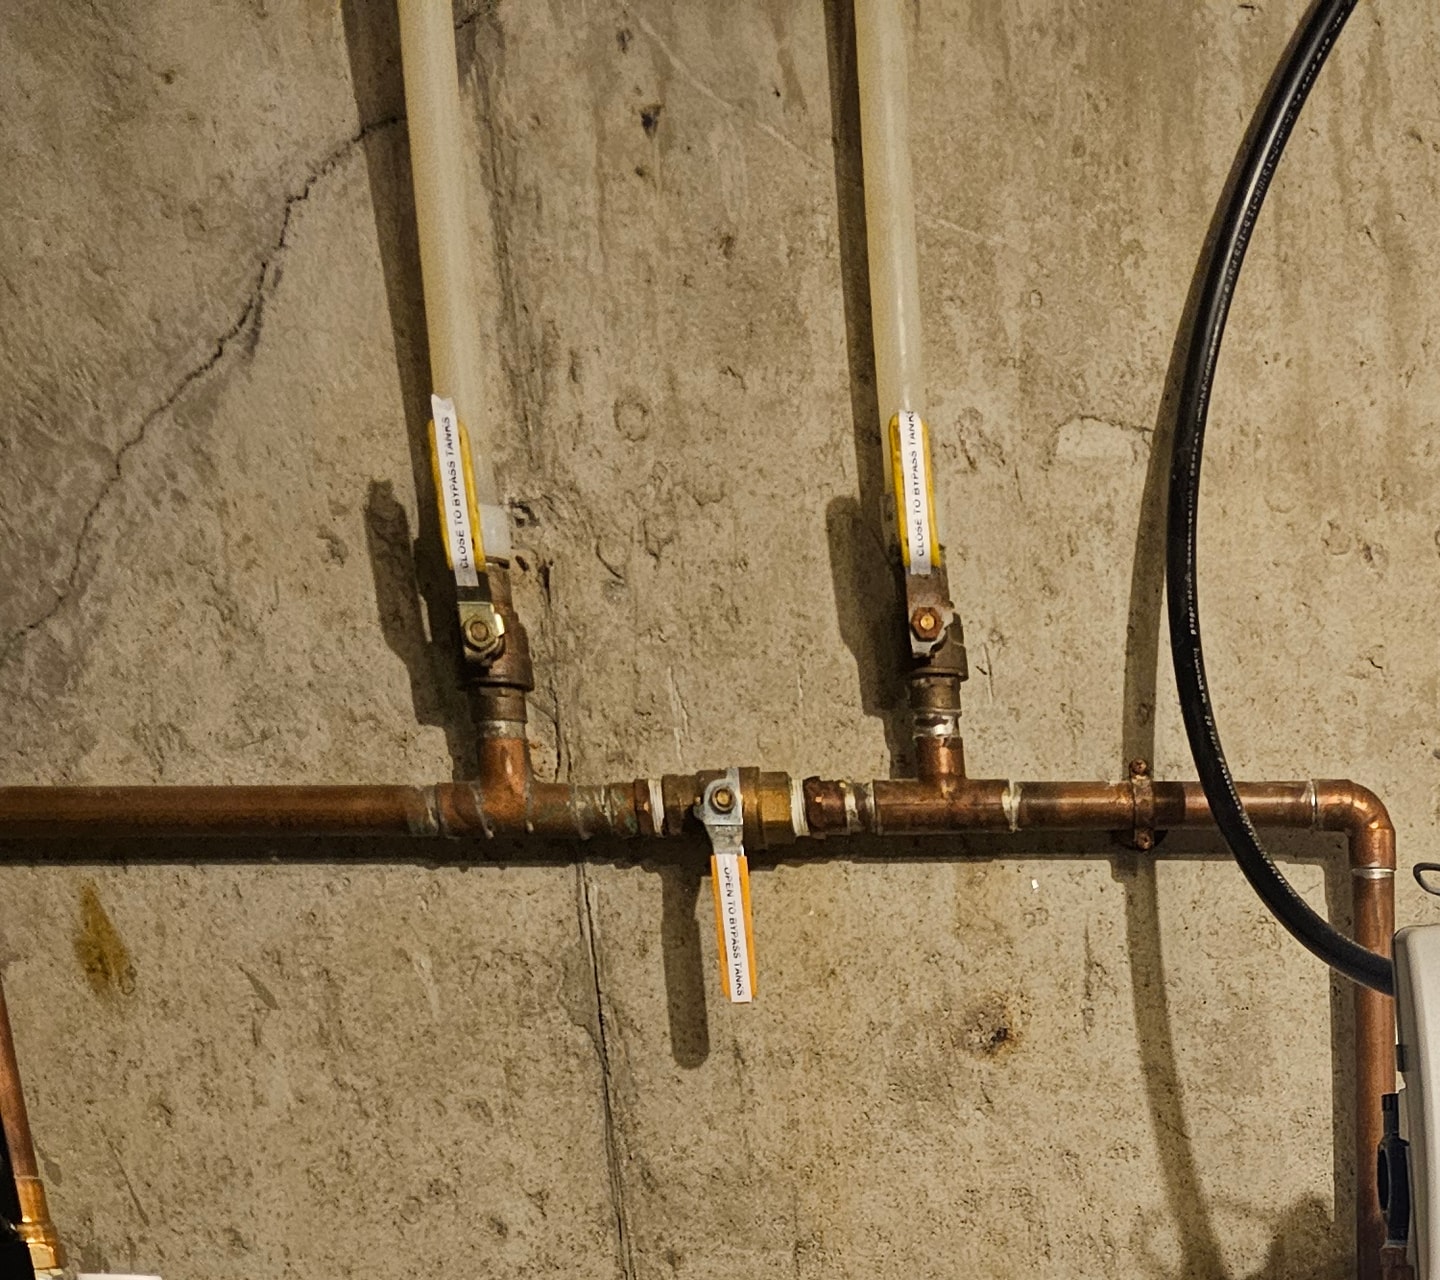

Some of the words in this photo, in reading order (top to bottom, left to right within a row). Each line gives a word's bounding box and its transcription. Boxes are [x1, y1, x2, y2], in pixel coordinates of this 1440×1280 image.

[442, 416, 455, 456] TANKS
[448, 463, 461, 507] BYPASS
[911, 451, 920, 496] BYPASS
[454, 510, 462, 526] TO
[914, 499, 921, 514] TO
[457, 530, 469, 570] CLOSE
[724, 867, 734, 899] OPEN
[728, 900, 736, 914] TO
[729, 917, 741, 960] BYPASS
[731, 962, 743, 997] TANKS
